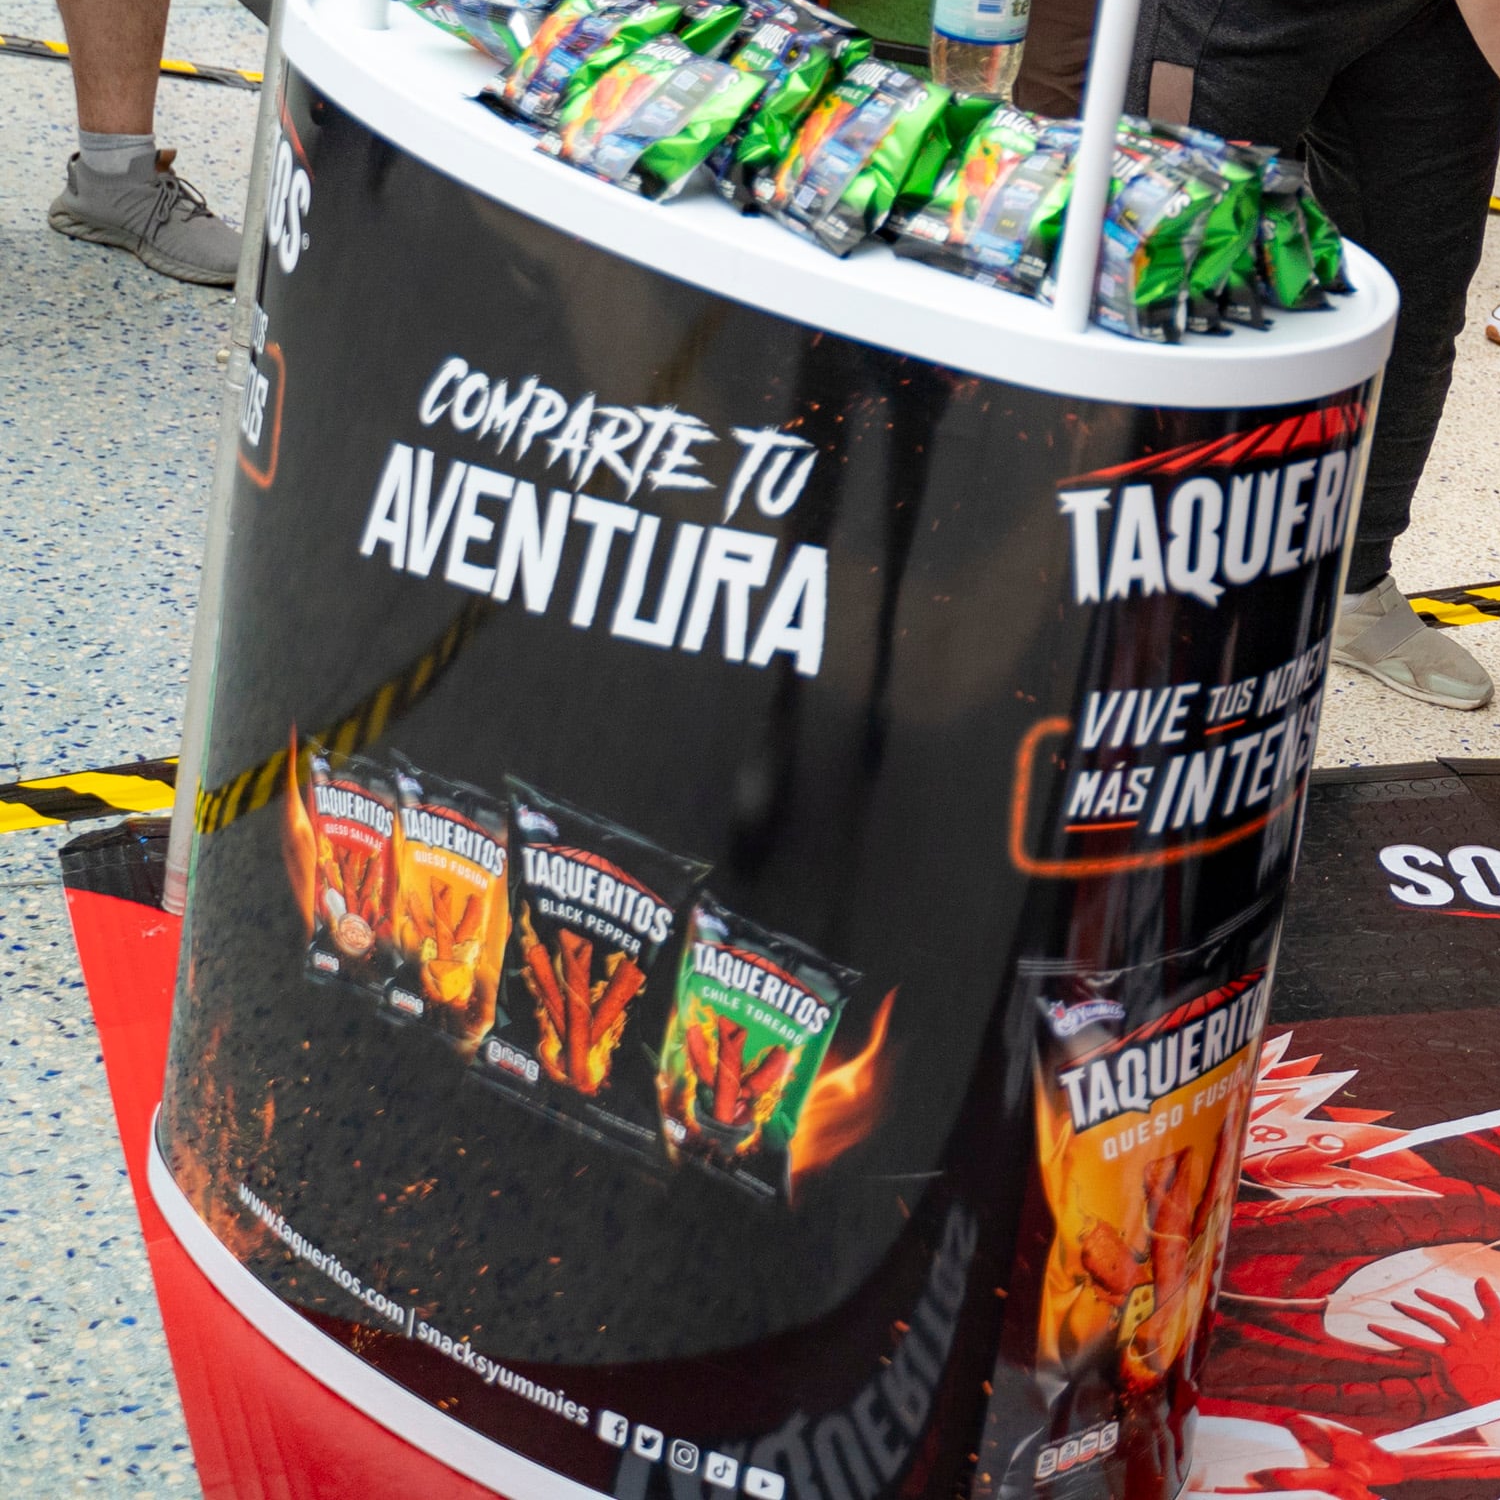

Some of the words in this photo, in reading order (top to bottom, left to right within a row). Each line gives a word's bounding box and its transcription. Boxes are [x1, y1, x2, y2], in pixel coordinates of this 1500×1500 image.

[419, 355, 720, 500] COMPARTE
[723, 424, 817, 524] TU
[358, 441, 829, 677] AVENTURA
[1079, 681, 1201, 752] VIVE
[1206, 679, 1255, 725] TUS
[314, 785, 395, 839] TAQUERITOS
[1067, 759, 1154, 820] MÁS
[400, 807, 507, 878] TAQUERITOS
[413, 850, 447, 869] QUESO
[522, 846, 674, 944] TAQUERITOS
[540, 897, 584, 924] BLACK
[584, 911, 642, 955] PEPPER
[693, 941, 831, 1035] TAQUERITOS
[701, 984, 741, 1010] CHILE
[744, 997, 804, 1047] TOREADO
[1102, 1104, 1184, 1162] QUESO
[237, 1180, 407, 1326] www.taqueritos.com
[415, 1317, 591, 1428] snacksyummies
